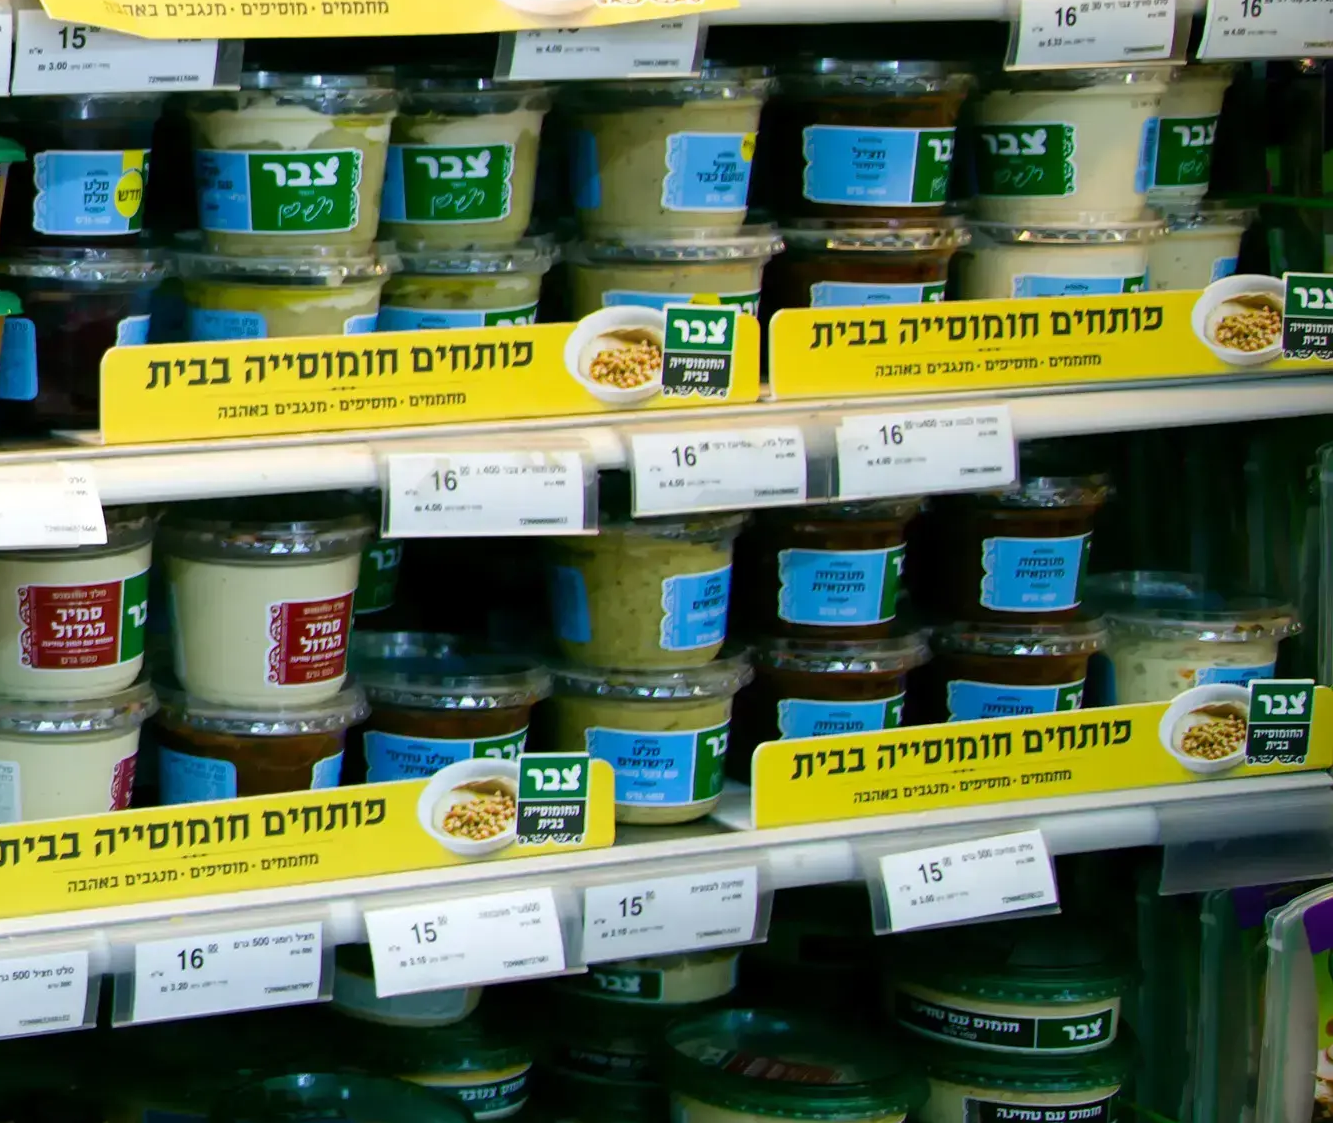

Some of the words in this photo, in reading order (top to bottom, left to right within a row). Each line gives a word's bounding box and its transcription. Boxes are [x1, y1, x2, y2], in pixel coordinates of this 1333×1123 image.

[1054, 4, 1075, 27] 16
[262, 156, 340, 187] צבר
[810, 320, 887, 348] בבית
[900, 313, 1038, 343] חומוסייה
[1050, 307, 1162, 335] פותחים
[245, 349, 397, 383] חומוסייה
[410, 341, 533, 372] פותחים
[146, 358, 231, 389] בבית
[56, 606, 102, 622] סמיר
[52, 622, 106, 638] הגדול
[878, 732, 1011, 772] חומוסייה
[1022, 720, 1131, 753] פותחים
[792, 748, 865, 779] בבית
[262, 799, 385, 836] פותחים
[95, 814, 249, 856] חומוסייה
[918, 861, 942, 883] 15
[177, 948, 204, 970] 16
